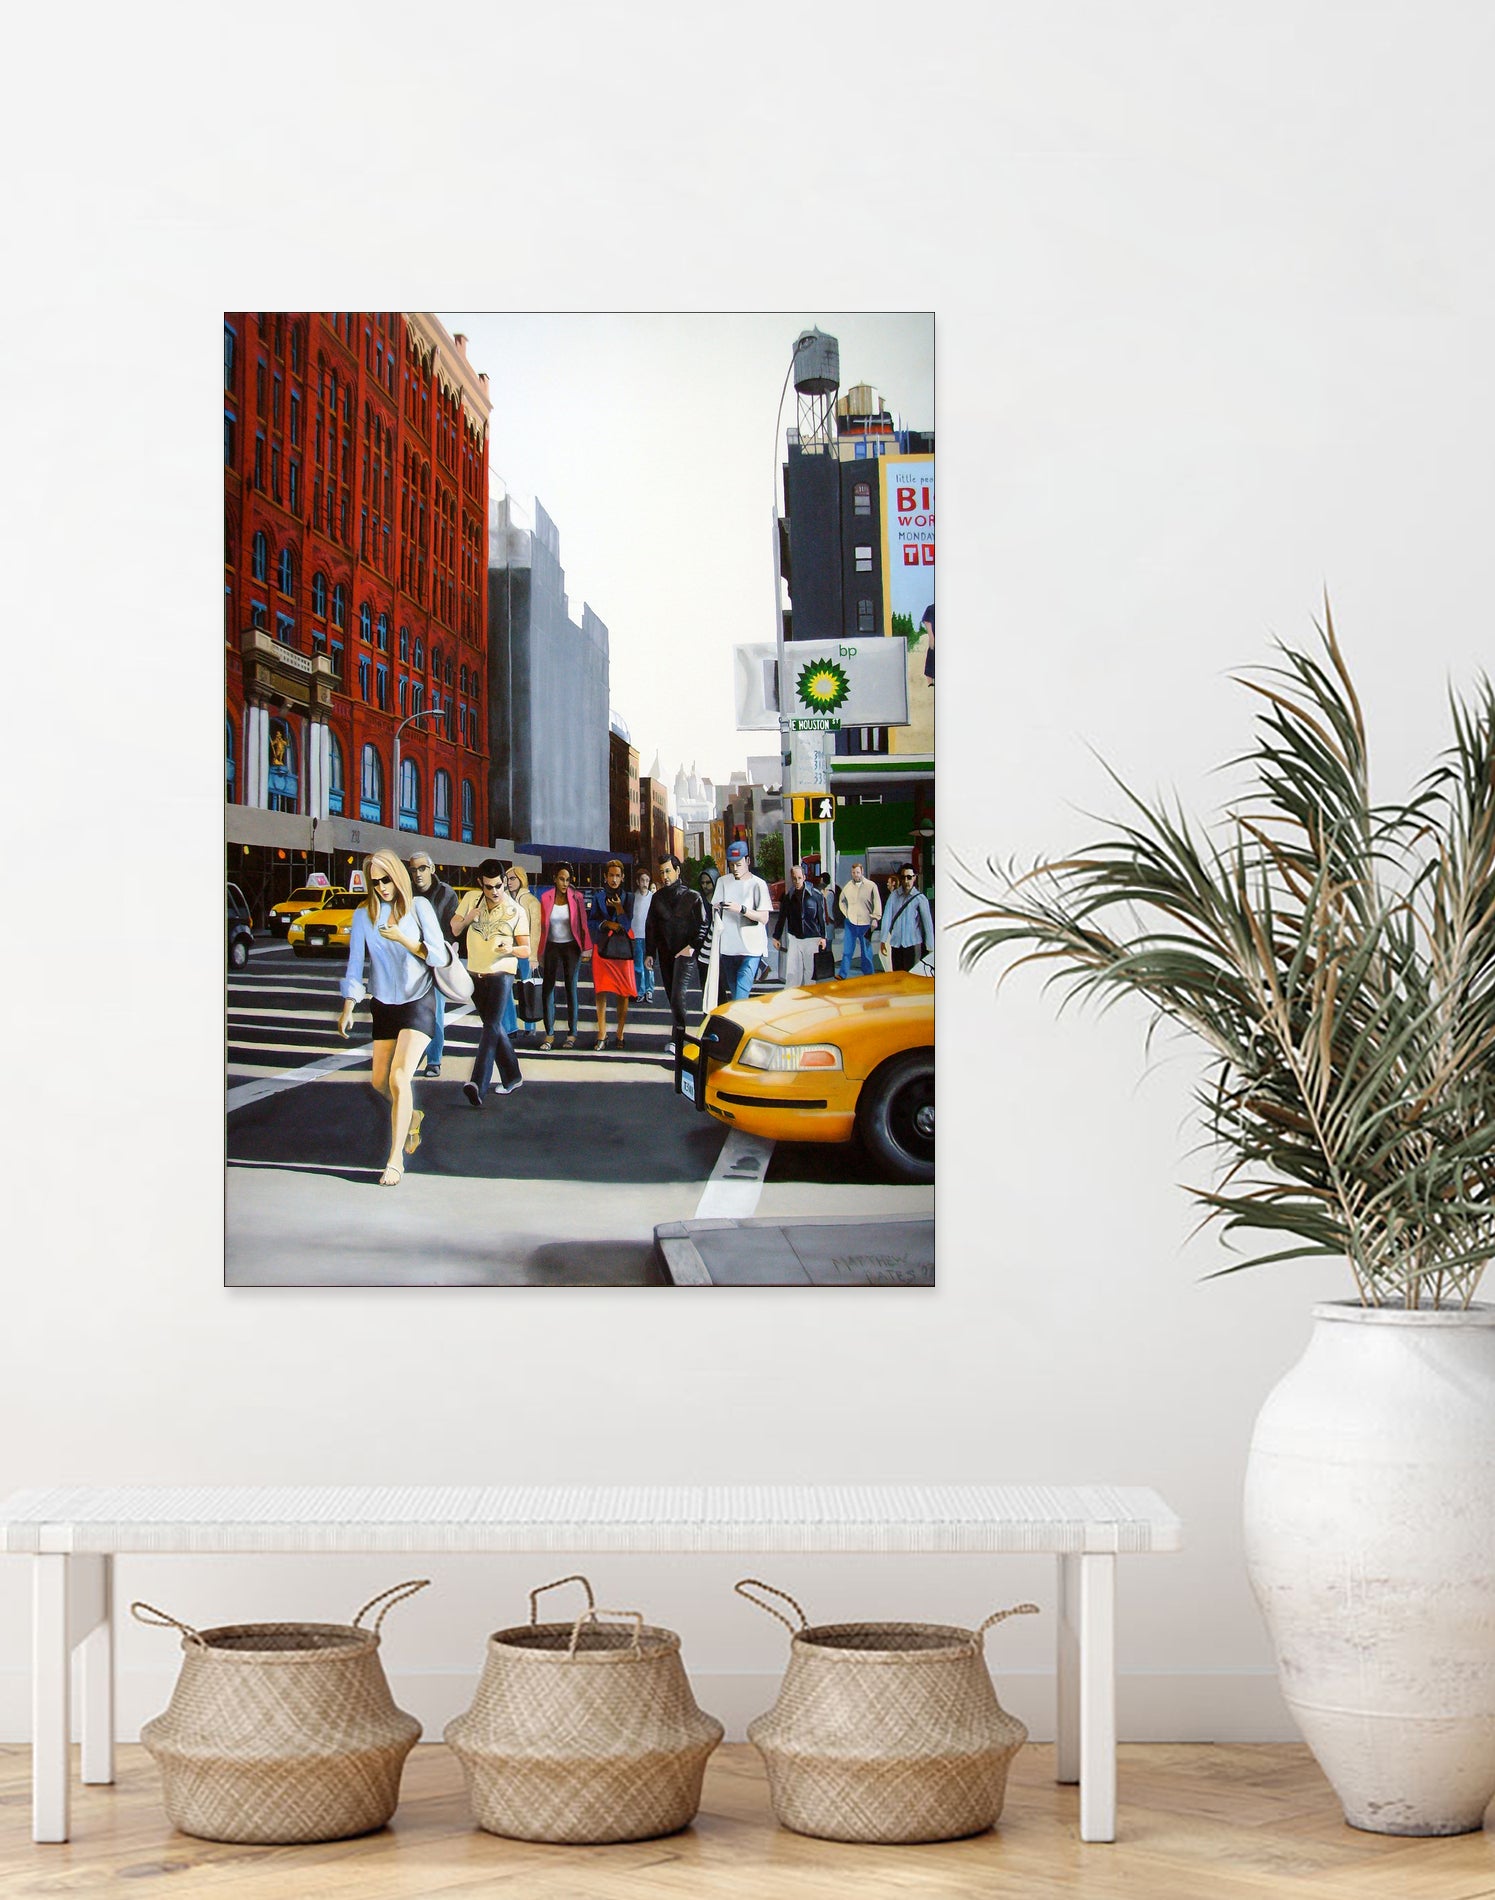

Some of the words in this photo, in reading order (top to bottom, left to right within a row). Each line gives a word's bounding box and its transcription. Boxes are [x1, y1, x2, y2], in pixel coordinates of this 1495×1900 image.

[896, 474, 917, 483] little
[897, 487, 935, 512] BI
[839, 644, 857, 660] bp
[792, 720, 797, 730] E
[798, 720, 830, 730] HOUSTON
